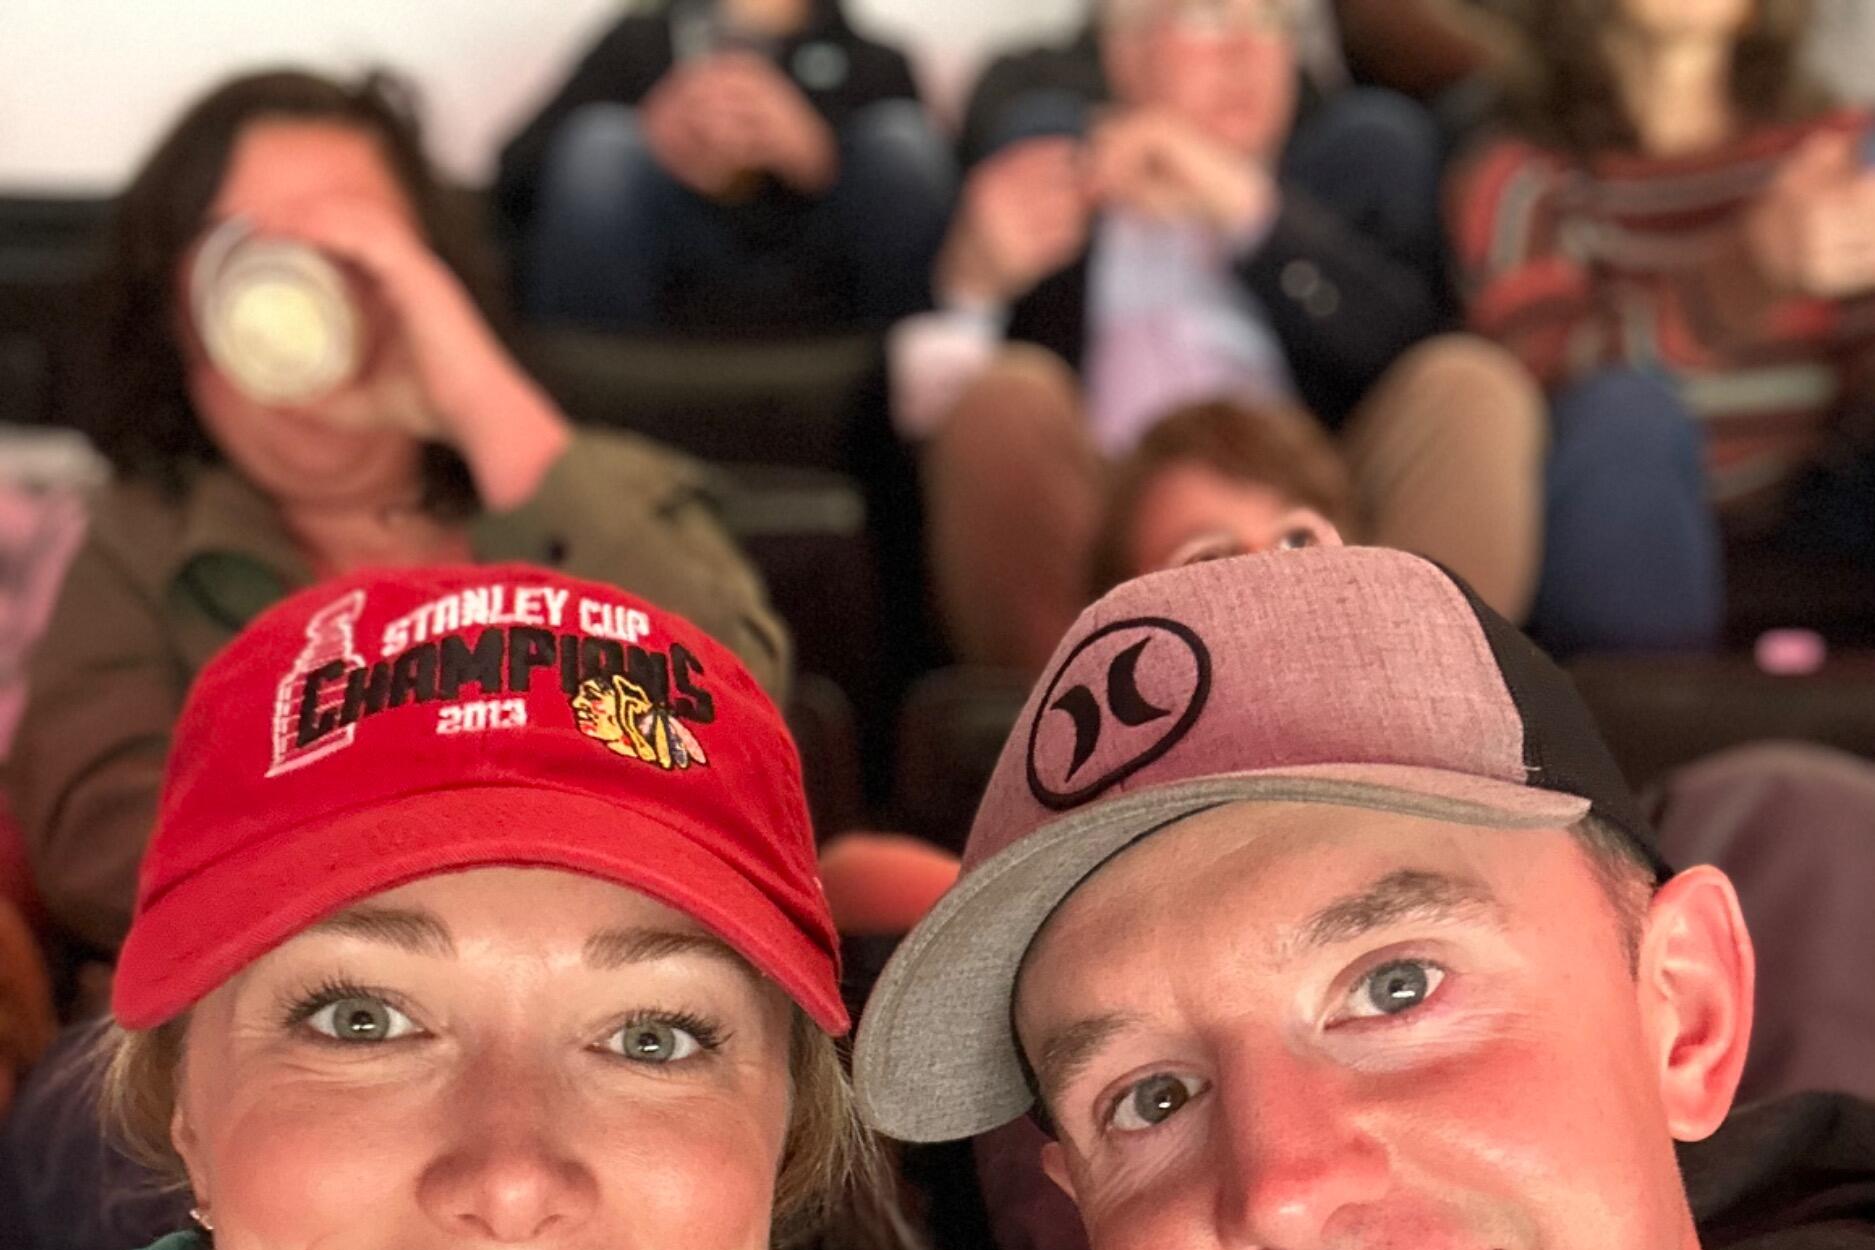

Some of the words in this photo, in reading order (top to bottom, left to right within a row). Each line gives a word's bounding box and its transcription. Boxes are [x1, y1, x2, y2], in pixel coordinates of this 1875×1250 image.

[381, 585, 569, 657] STANLEY
[579, 598, 650, 641] CUP
[297, 625, 715, 747] CHAMPIONS
[436, 699, 527, 735] 2013
